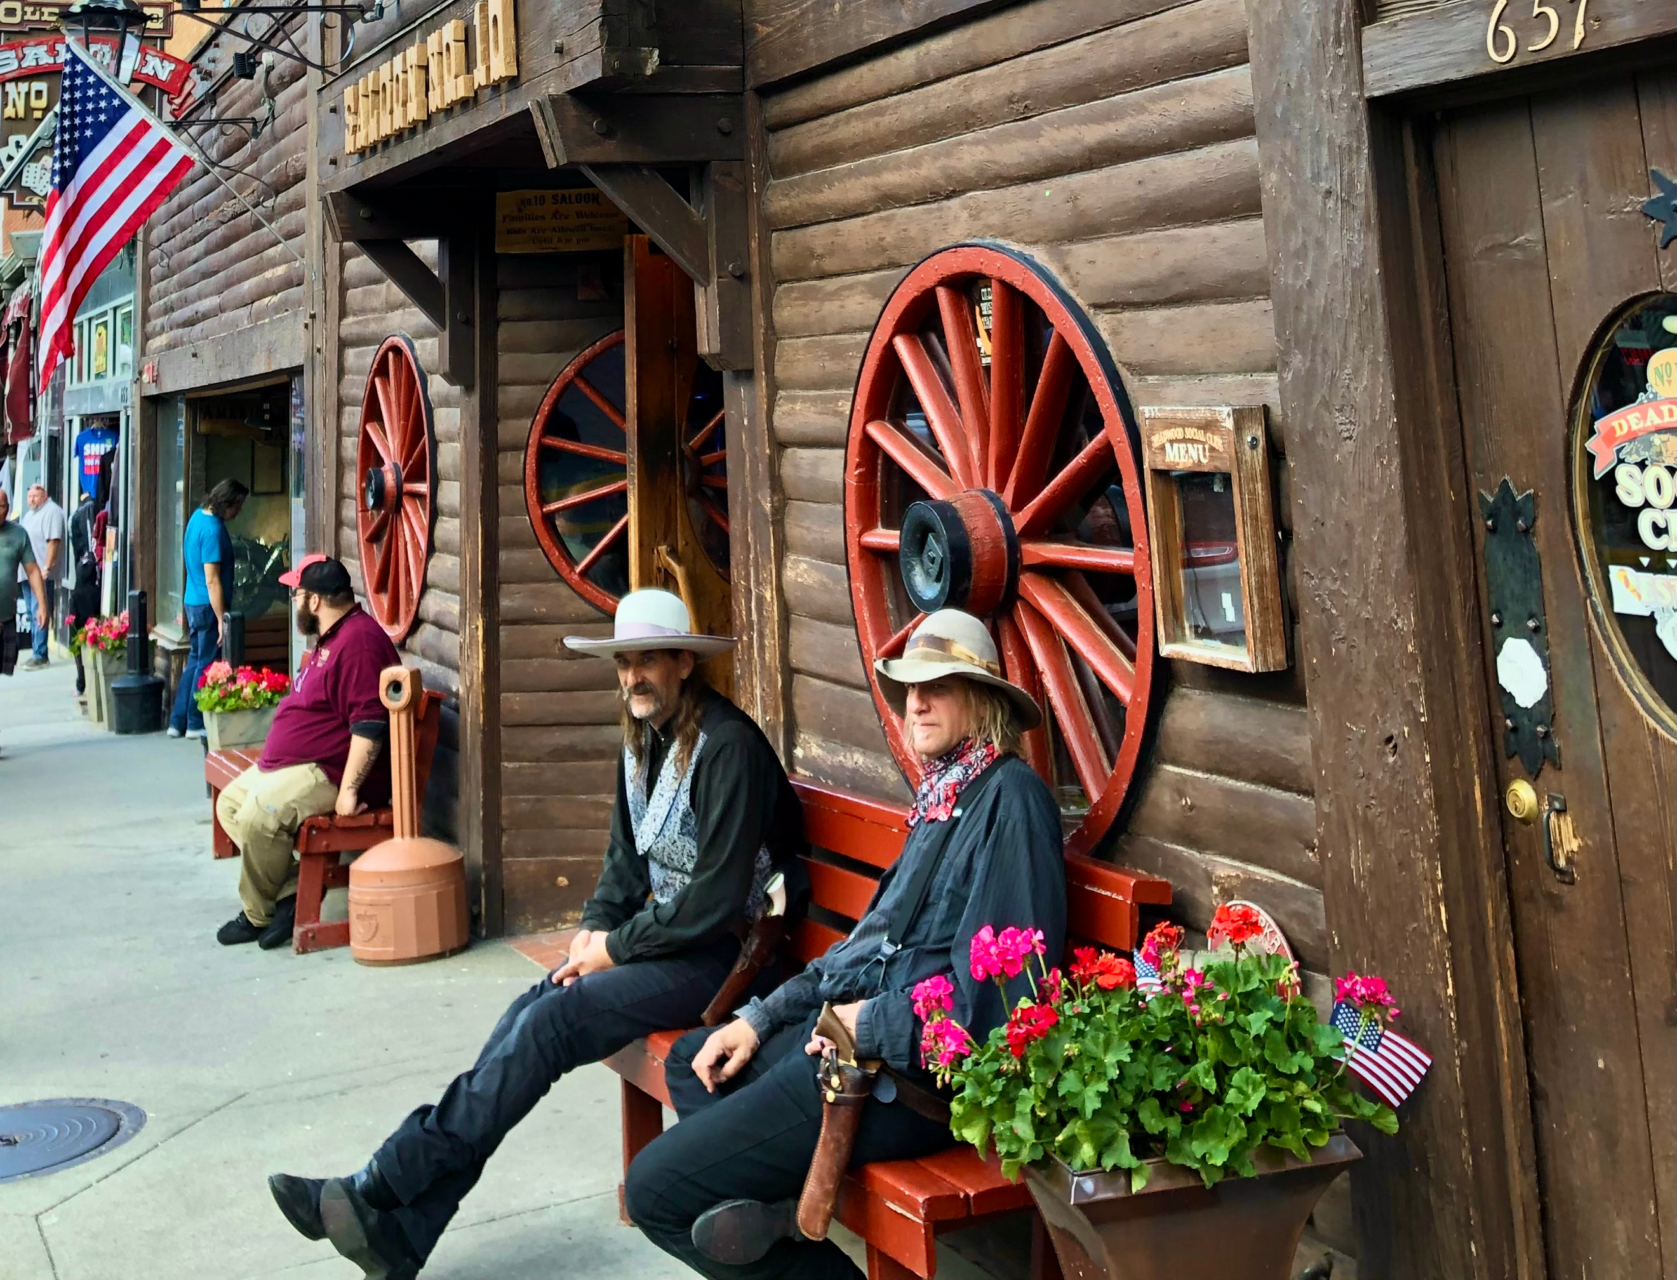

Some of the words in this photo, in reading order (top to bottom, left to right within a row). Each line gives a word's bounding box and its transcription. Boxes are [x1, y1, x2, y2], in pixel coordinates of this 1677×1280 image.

[551, 192, 601, 206] SALOON
[502, 213, 546, 223] Families
[550, 210, 571, 221] Are
[576, 210, 620, 221] Welcome
[1164, 442, 1210, 464] MENU
